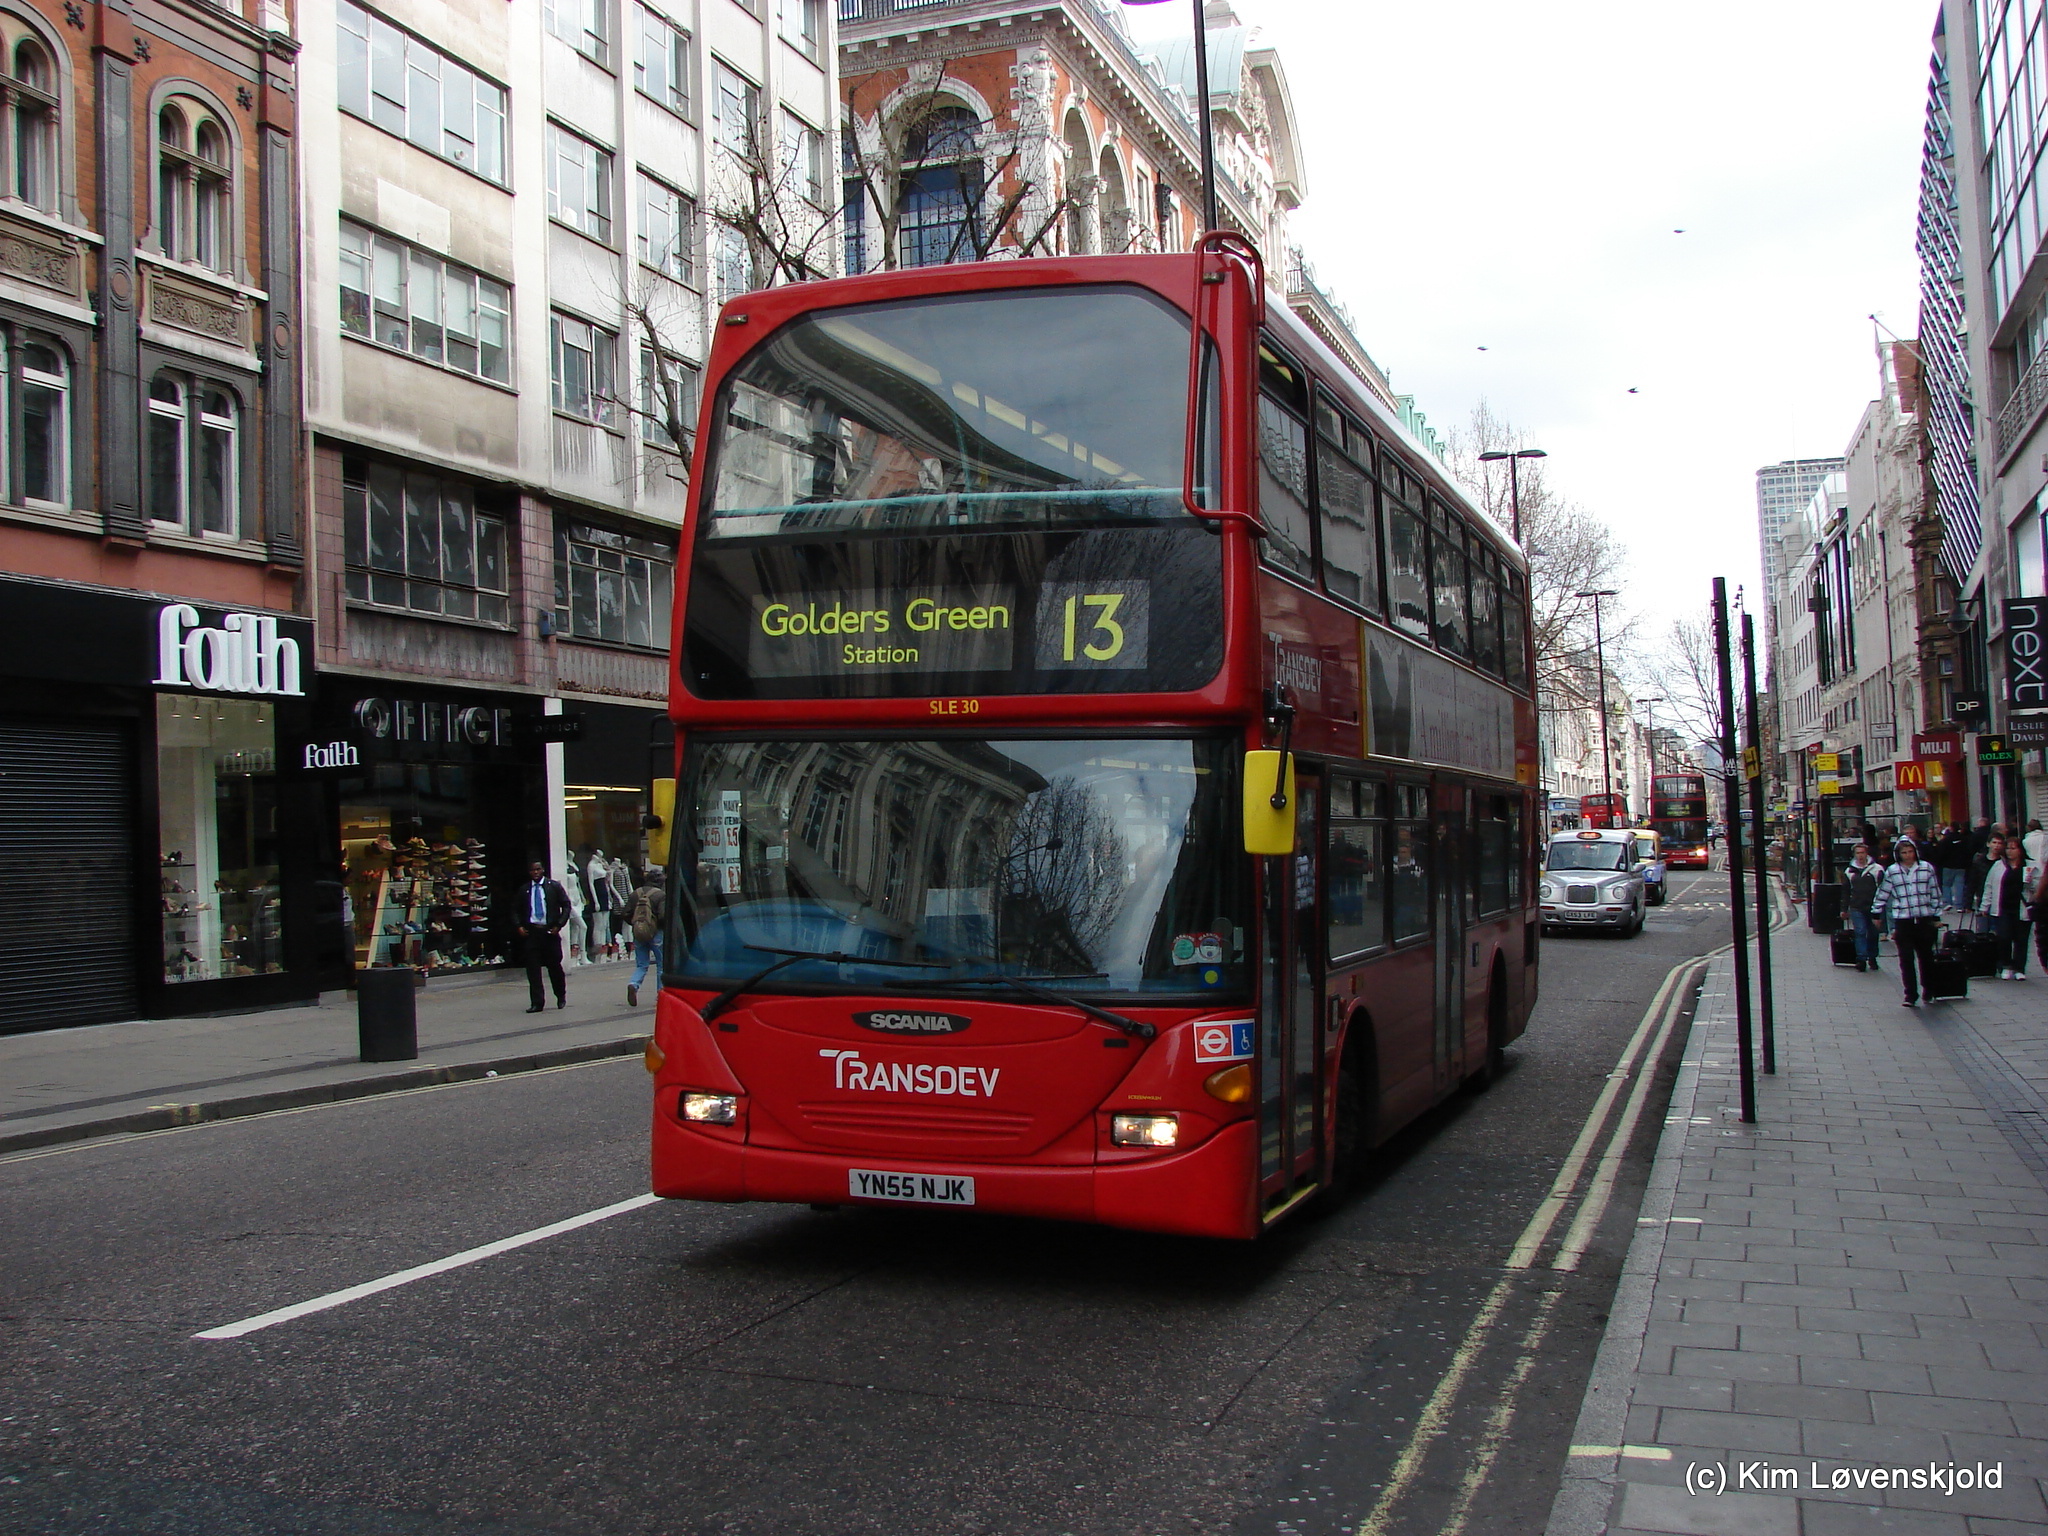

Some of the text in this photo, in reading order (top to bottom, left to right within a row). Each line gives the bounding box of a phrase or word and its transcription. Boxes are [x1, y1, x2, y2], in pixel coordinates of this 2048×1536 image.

[761, 598, 1009, 637] Golders Green
[1063, 593, 1126, 662] 13
[152, 603, 306, 697] faith
[842, 644, 919, 665] Station
[1268, 631, 1322, 693] TRANSDEV
[2010, 604, 2045, 702] next
[929, 699, 979, 715] SLE 30
[1955, 701, 1980, 712] DP
[353, 697, 513, 748] OFFICE
[2010, 721, 2046, 732] LESLIE
[1920, 741, 1951, 755] MUJI
[2012, 732, 2045, 743] DAVIS
[303, 741, 360, 769] faith
[1744, 750, 1756, 777] H
[1979, 751, 2013, 761] ROLEX
[870, 1013, 953, 1031] SCANIA
[819, 1049, 1000, 1097] TRANSDEV
[858, 1173, 966, 1201] YN55 NJK
